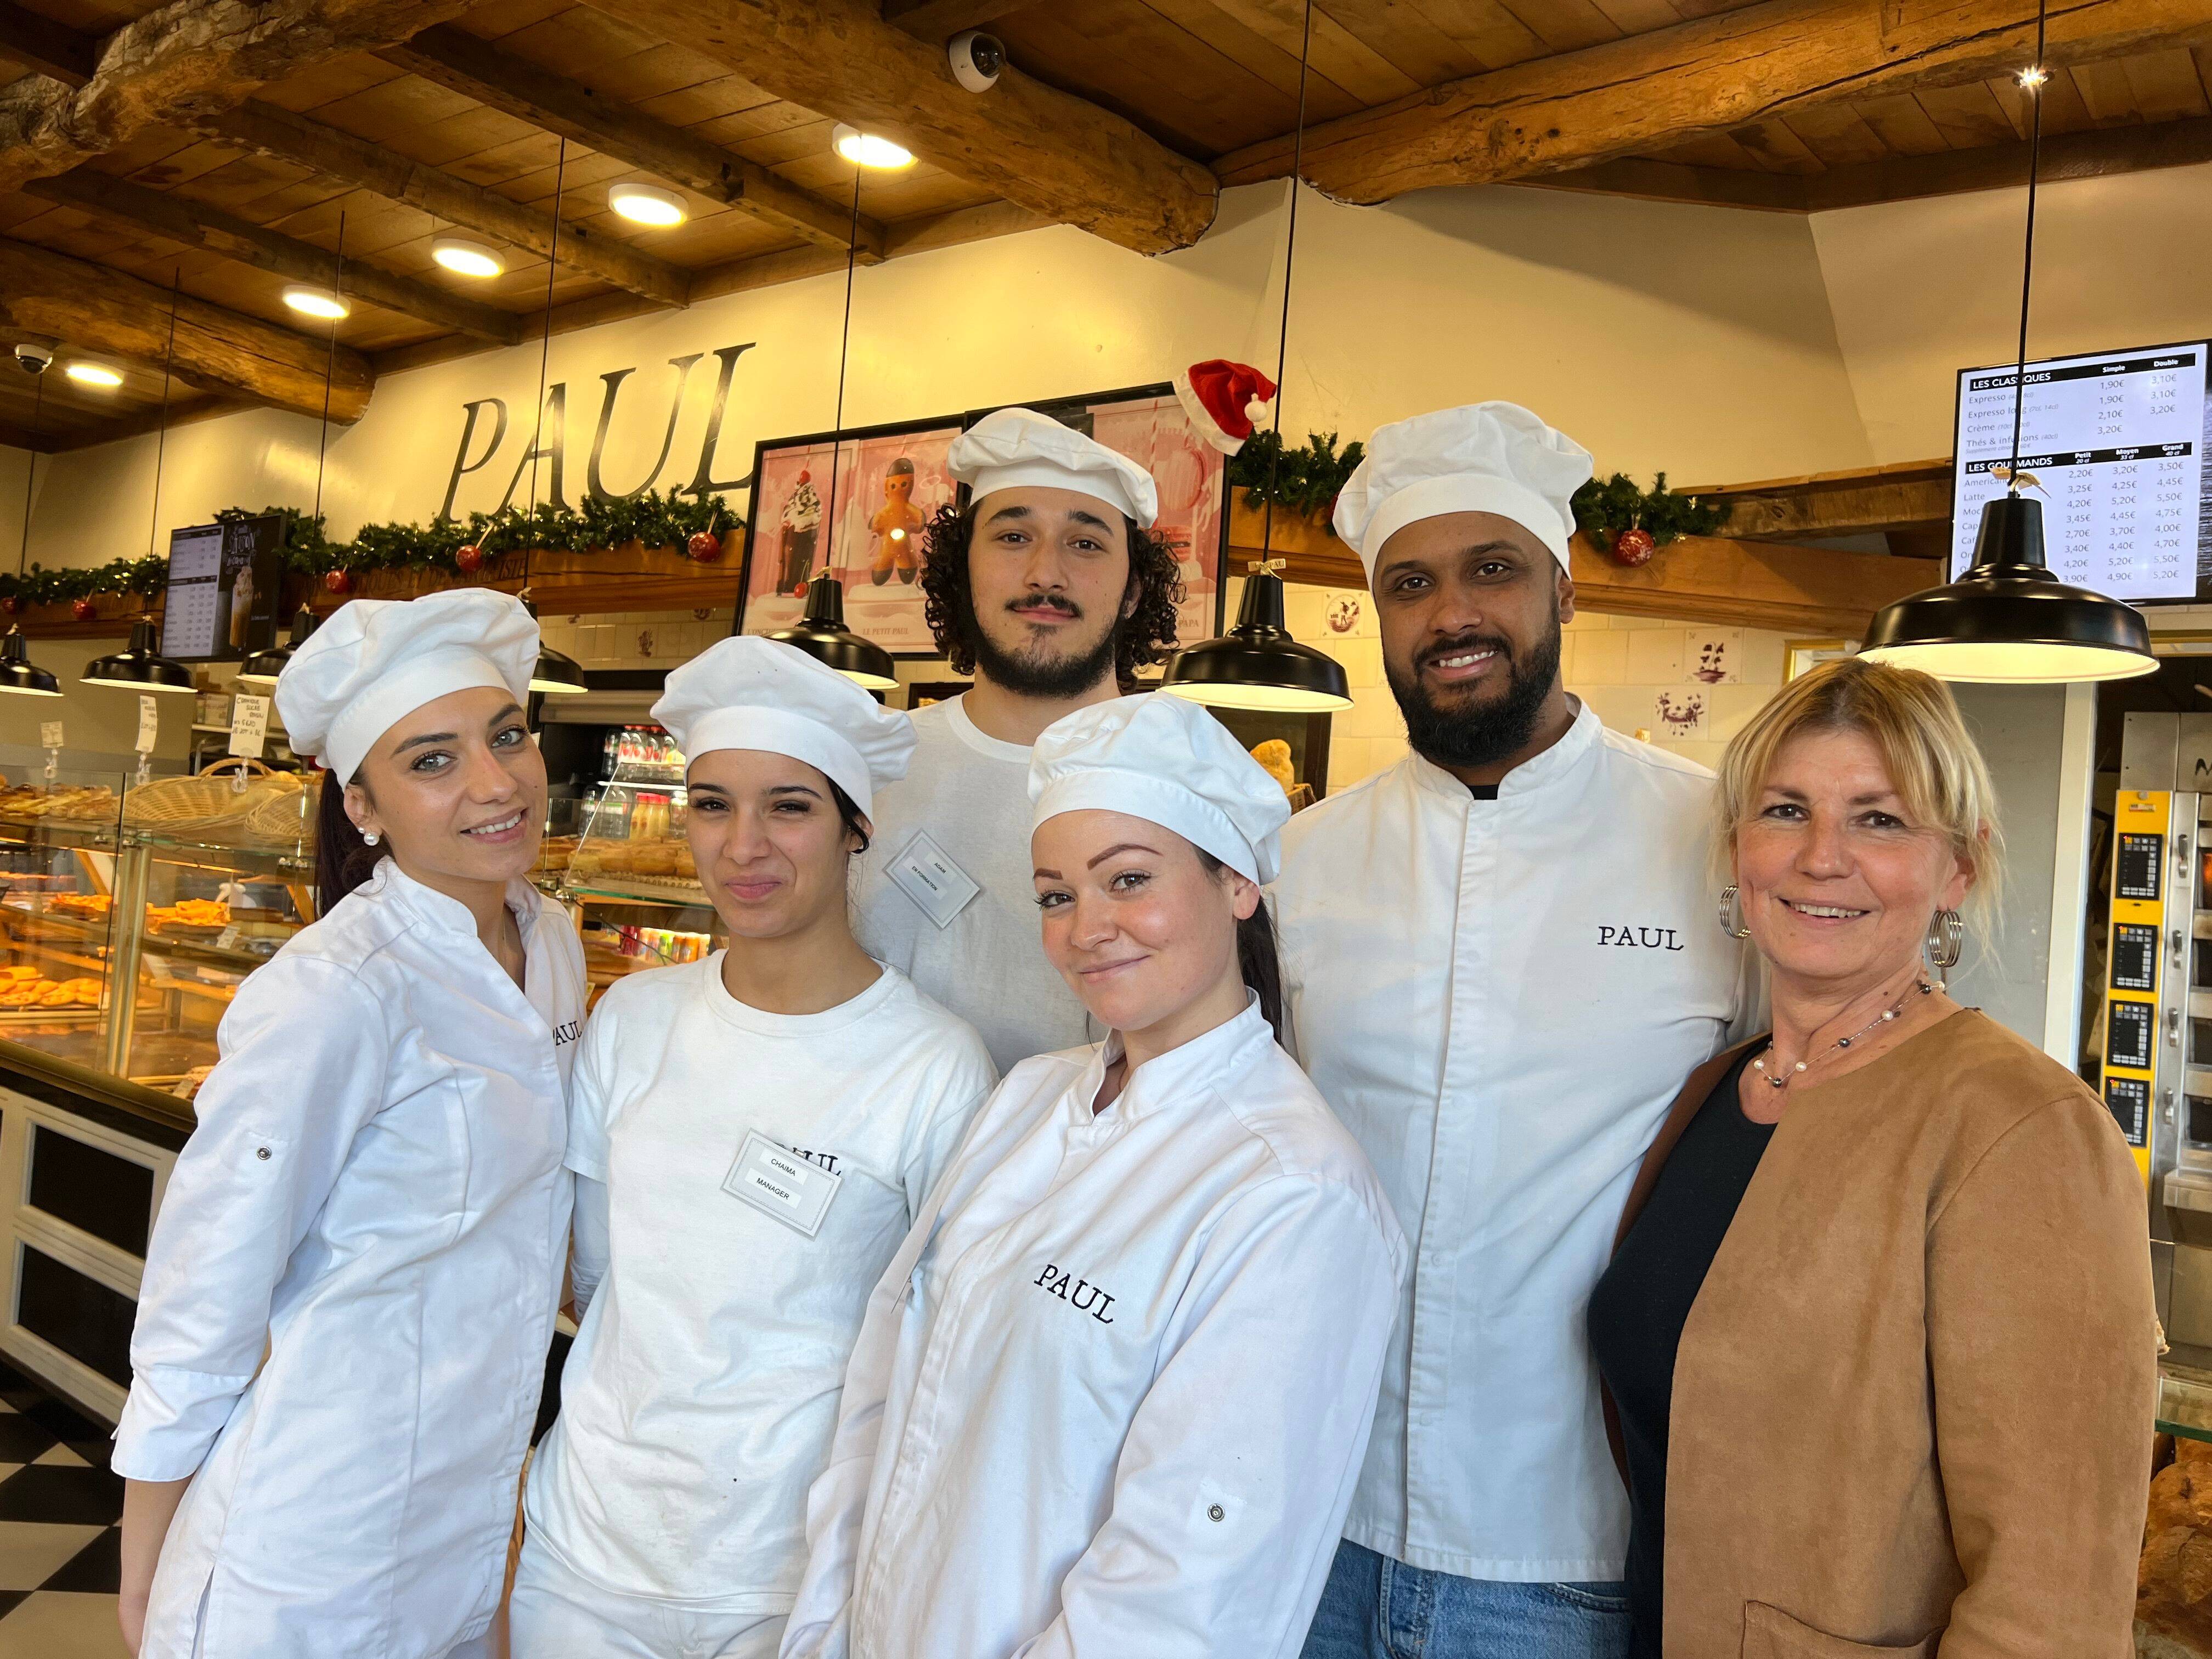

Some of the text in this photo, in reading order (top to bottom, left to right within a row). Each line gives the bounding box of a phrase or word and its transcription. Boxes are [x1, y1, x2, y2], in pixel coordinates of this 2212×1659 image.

[1973, 380, 1989, 388] LES
[1992, 373, 2051, 387] CLASIQUES
[2102, 365, 2125, 373] Simple
[1969, 394, 2006, 404] Expresso
[2100, 380, 2125, 390] 1,90€
[2152, 374, 2177, 384] 3,10€
[1968, 409, 2005, 419] Expresso
[2100, 395, 2124, 405] 1,90€
[2151, 389, 2176, 399] 3,10€
[1967, 424, 1995, 433] Crème
[2098, 410, 2123, 420] 2,10€
[2150, 405, 2176, 415] 3,20€
[439, 342, 756, 523] PAUL
[1967, 439, 1986, 447] Thés
[1999, 435, 2039, 444] infions
[2098, 425, 2123, 435] 3,20€
[1968, 463, 1985, 472] LES
[1988, 457, 2053, 470] GOUMANDS
[2069, 469, 2094, 478] 2,20€
[2113, 465, 2138, 475] 3,20€
[2158, 461, 2184, 471] 3,50€
[2068, 484, 2093, 494] 3,25€
[2112, 481, 2137, 490] 4,25€
[2157, 477, 2183, 487] 4,45€
[2067, 499, 2092, 509] 4,20€
[2112, 496, 2137, 506] 5,20€
[2157, 493, 2182, 503] 5,50€
[2067, 514, 2091, 524] 3,45€
[2111, 511, 2136, 521] 4,45€
[2155, 508, 2182, 518] 4,75€
[2066, 529, 2090, 539] 2,70€
[2110, 527, 2135, 537] 3,70€
[2155, 524, 2181, 534] 4,00€
[2064, 539, 2181, 554] 3,40€ 4,40€ 4,70€
[2064, 555, 2180, 569] 4,20€ 5,20€ 5,50€
[2063, 571, 2180, 584] 3,90€ 4,90€ 5,20€
[1597, 926, 1684, 951] PAUL
[770, 1158, 796, 1177] CHAIMA
[756, 1177, 789, 1200] MANAGER
[1034, 1264, 1115, 1324] PAUL
